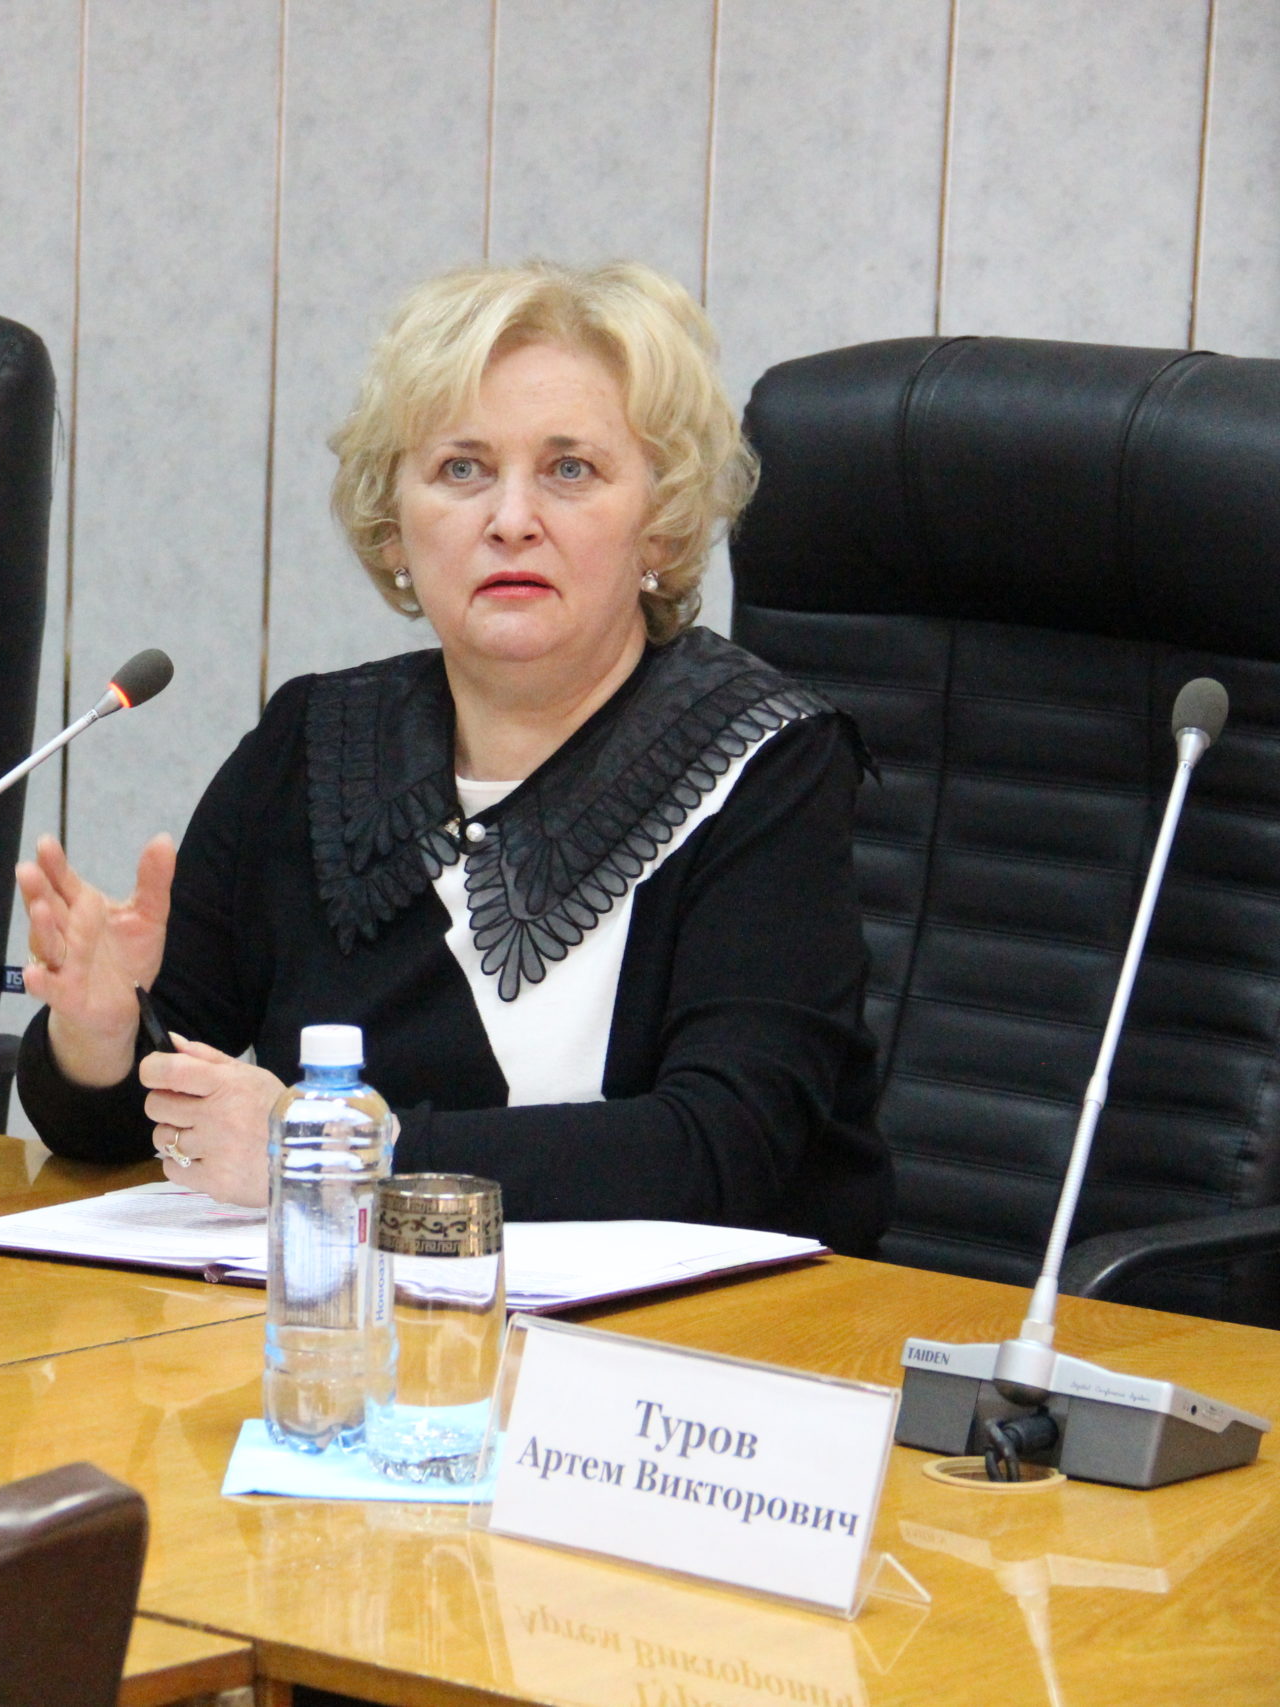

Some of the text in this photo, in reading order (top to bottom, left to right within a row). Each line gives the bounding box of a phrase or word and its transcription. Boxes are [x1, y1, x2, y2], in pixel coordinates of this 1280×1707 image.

[907, 1346, 951, 1366] TAIDEN
[635, 1399, 759, 1460] Туров
[516, 1435, 860, 1537] Артем Викторович
